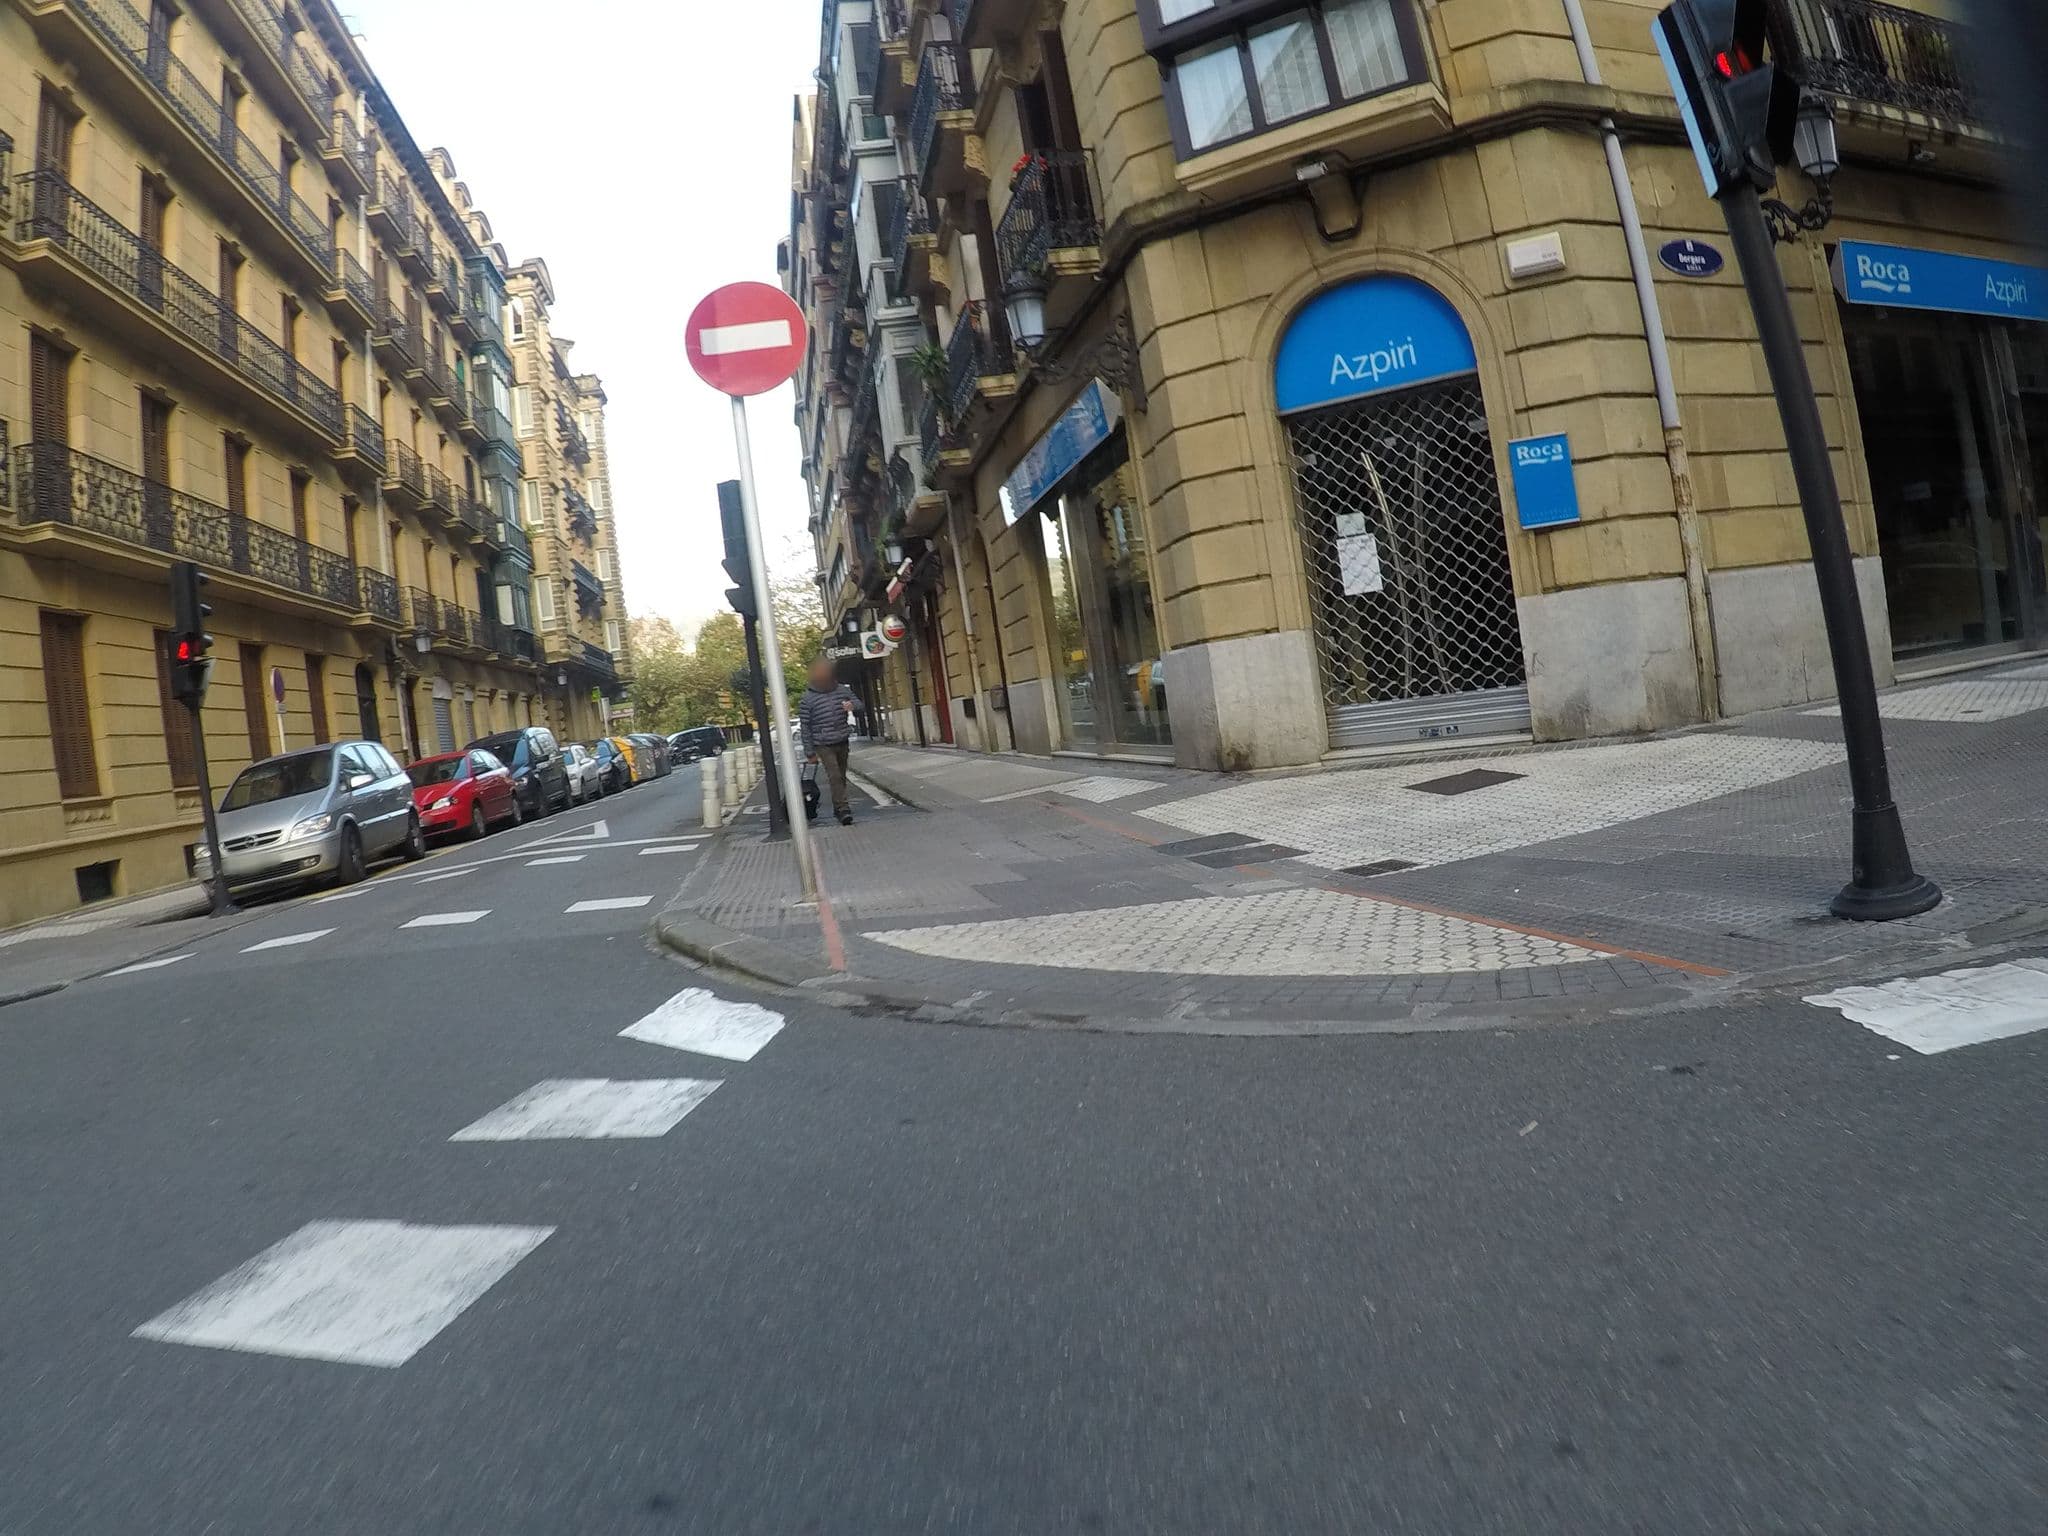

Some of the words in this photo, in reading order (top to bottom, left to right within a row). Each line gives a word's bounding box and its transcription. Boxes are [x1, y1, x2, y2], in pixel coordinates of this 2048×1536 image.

[1856, 254, 1911, 282] Roca
[1985, 273, 2028, 308] Azpiri
[1330, 336, 1417, 385] Azpiri
[1516, 443, 1563, 460] Roca
